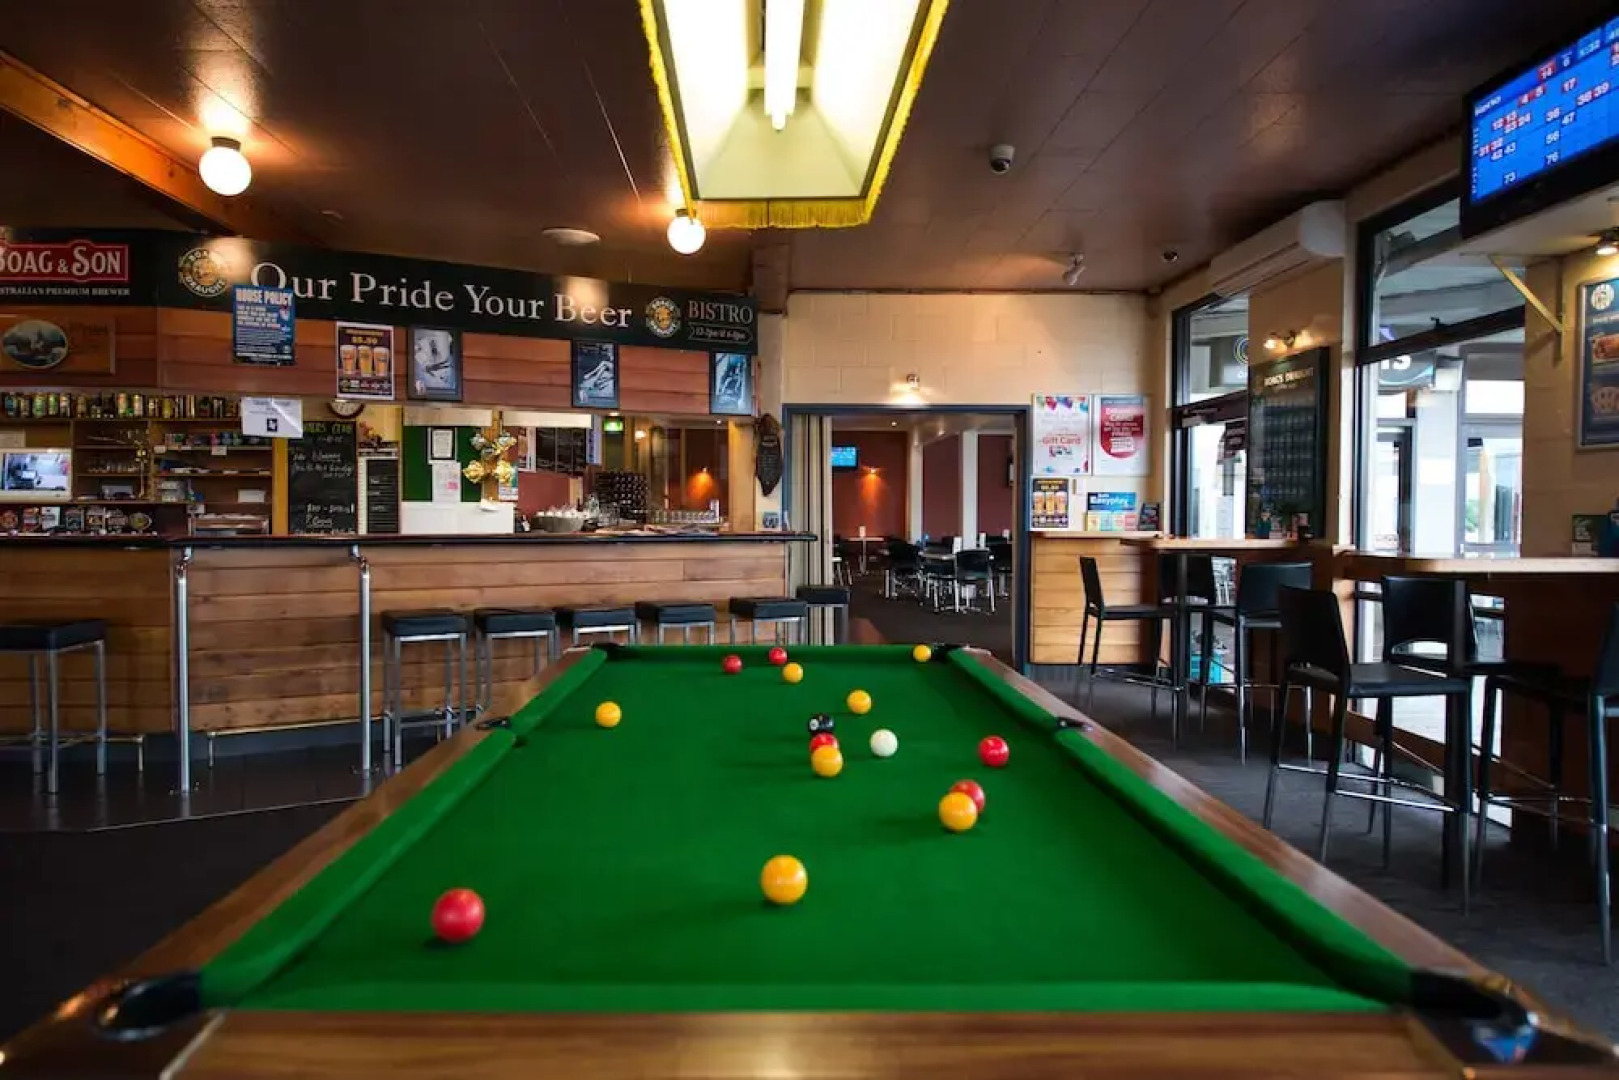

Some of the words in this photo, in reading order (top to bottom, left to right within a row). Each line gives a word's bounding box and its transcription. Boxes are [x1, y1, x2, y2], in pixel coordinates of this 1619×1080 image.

[1563, 77, 1576, 92] 17
[1479, 146, 1491, 157] 31
[1593, 82, 1609, 98] 39
[1562, 111, 1575, 125] 47
[1504, 171, 1516, 184] 73
[1546, 152, 1559, 165] 76
[57, 258, 69, 273] &
[46, 287, 89, 296] PREMIUM
[92, 287, 130, 296] BREWER
[250, 261, 337, 300] Our
[350, 271, 454, 311] Pride
[464, 284, 545, 321] Your
[553, 293, 633, 329] Beer
[688, 299, 753, 325] BISTRO
[1042, 436, 1058, 445] Gift
[1060, 436, 1081, 445] Card
